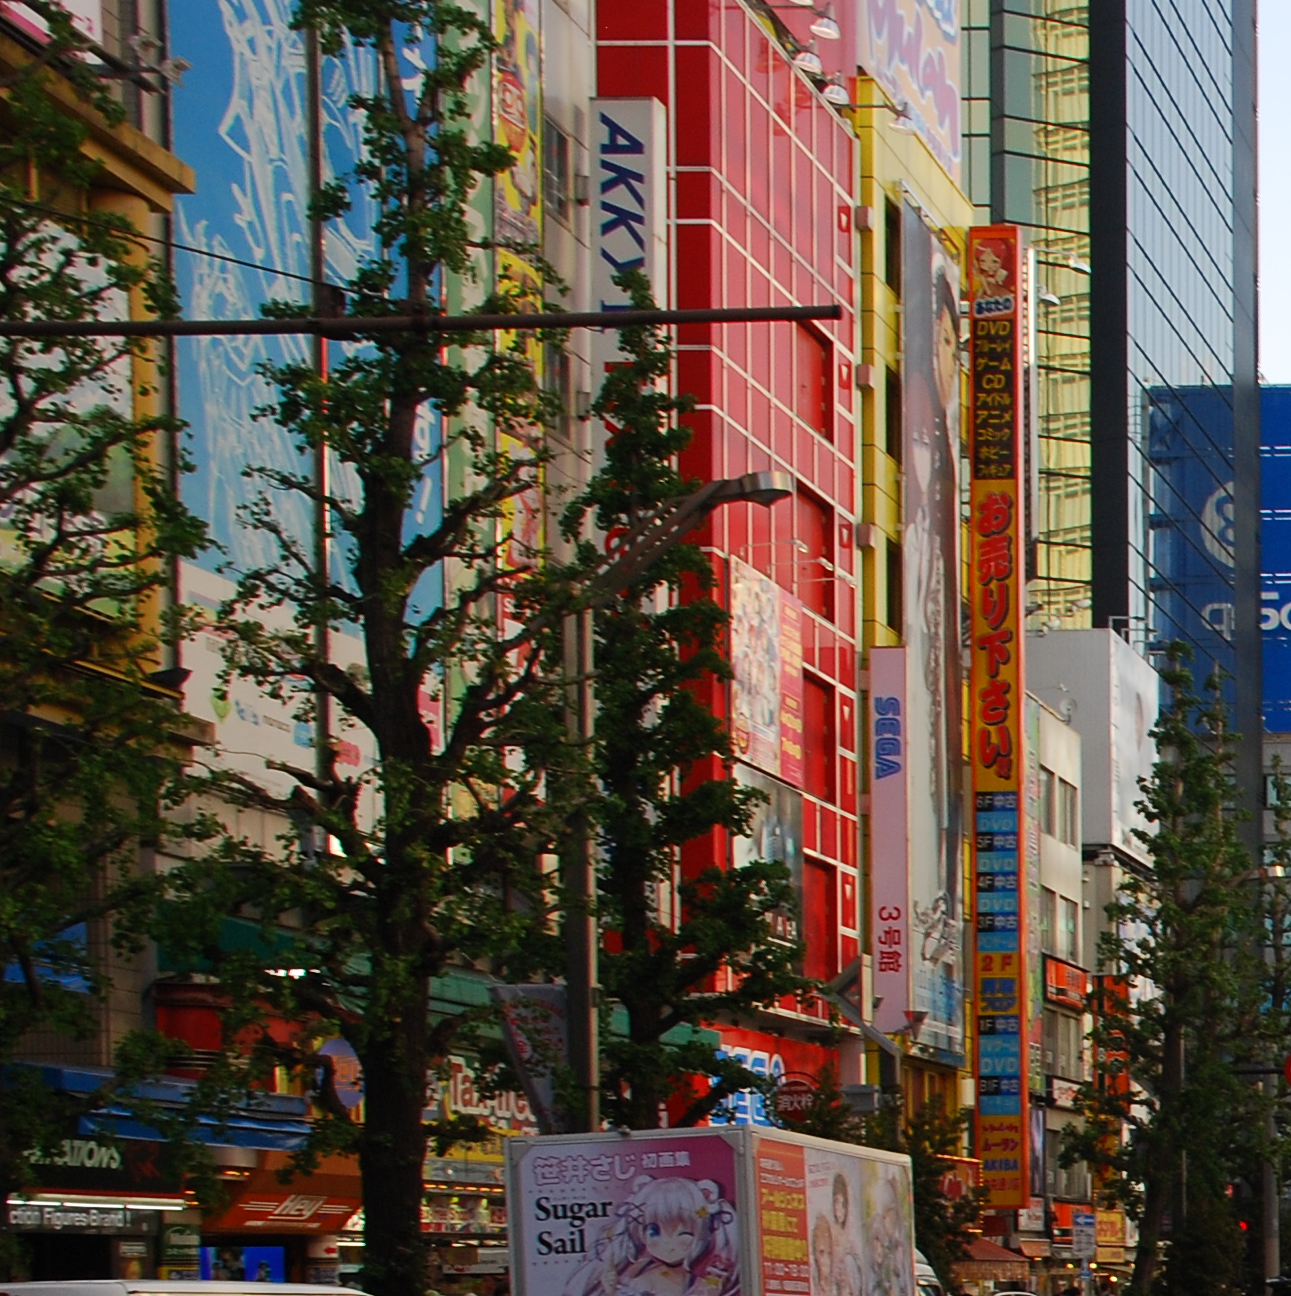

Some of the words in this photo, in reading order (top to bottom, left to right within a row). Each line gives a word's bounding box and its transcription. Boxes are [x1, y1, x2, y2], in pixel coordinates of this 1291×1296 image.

[977, 321, 1010, 336] DVD
[976, 359, 1013, 371] ゲーム
[982, 375, 1006, 389] CD
[976, 410, 1013, 423] アニメ
[874, 696, 901, 781] SEGA
[994, 795, 1017, 809] 中古
[994, 836, 1017, 848] 中古
[977, 877, 993, 889] 4F
[994, 876, 1017, 889] 中古
[977, 917, 993, 929] 3F
[994, 916, 1017, 929] 中古
[876, 905, 902, 973] 3号館
[995, 1018, 1019, 1032] 中古
[533, 1153, 636, 1186] 笹井さじ
[984, 1159, 1019, 1172] AKIBA
[272, 1195, 325, 1217] Hey
[535, 1197, 612, 1228] Sugar
[43, 1207, 89, 1230] Figures
[90, 1209, 124, 1227] Brand
[537, 1229, 588, 1256] Sail
